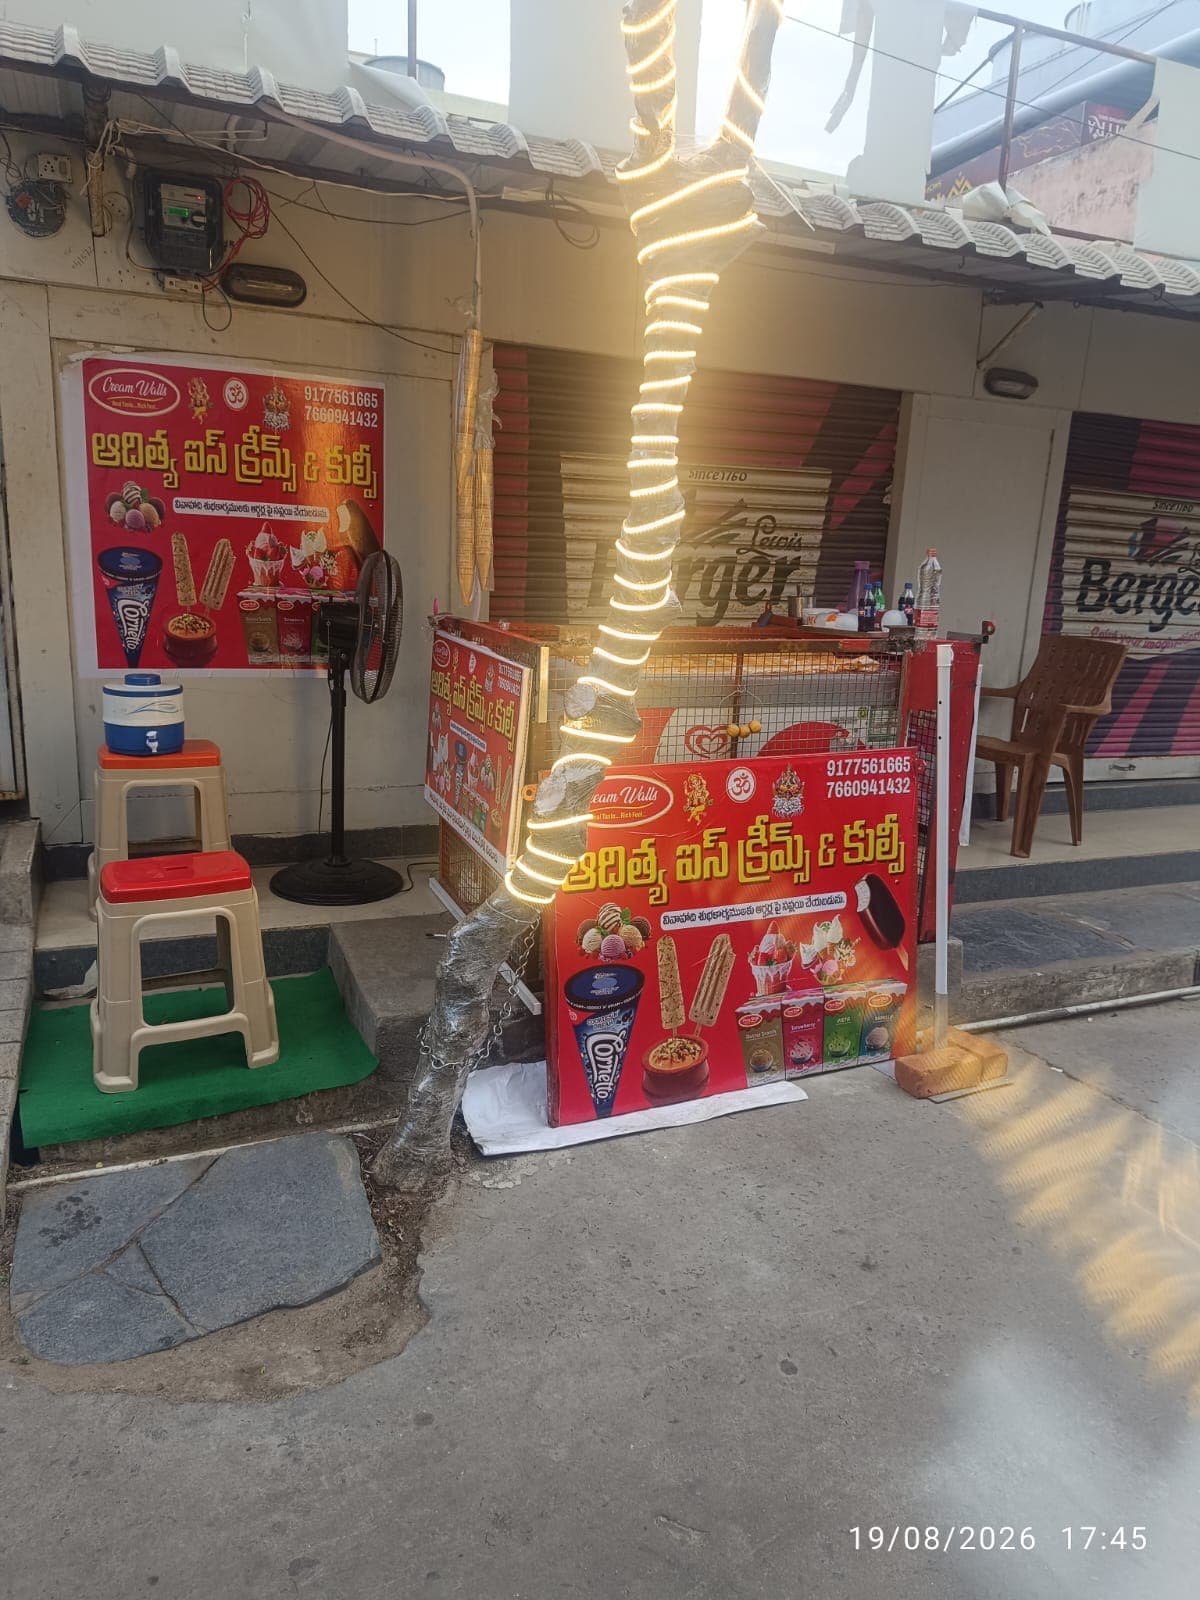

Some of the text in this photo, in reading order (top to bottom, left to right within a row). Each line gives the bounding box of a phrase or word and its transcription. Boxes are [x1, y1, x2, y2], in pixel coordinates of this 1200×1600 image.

[102, 376, 167, 396] Cream Walls
[303, 385, 378, 408] 9177561665
[304, 406, 378, 428] 7660941432
[91, 430, 179, 488] ఆదిత్య
[184, 429, 228, 475] ఐస్
[235, 425, 298, 493] క్రీమ్స్
[304, 451, 320, 482] &
[1075, 557, 1200, 632] Berge
[826, 757, 911, 777] 9177561665
[619, 786, 658, 804] Walls
[826, 777, 911, 799] 7660941432
[562, 838, 669, 905] ఆదిత్య
[676, 827, 727, 881] ఐస్
[737, 815, 811, 884] క్రీమ్స్
[818, 833, 836, 867] &
[585, 1029, 627, 1099] Cornetto
